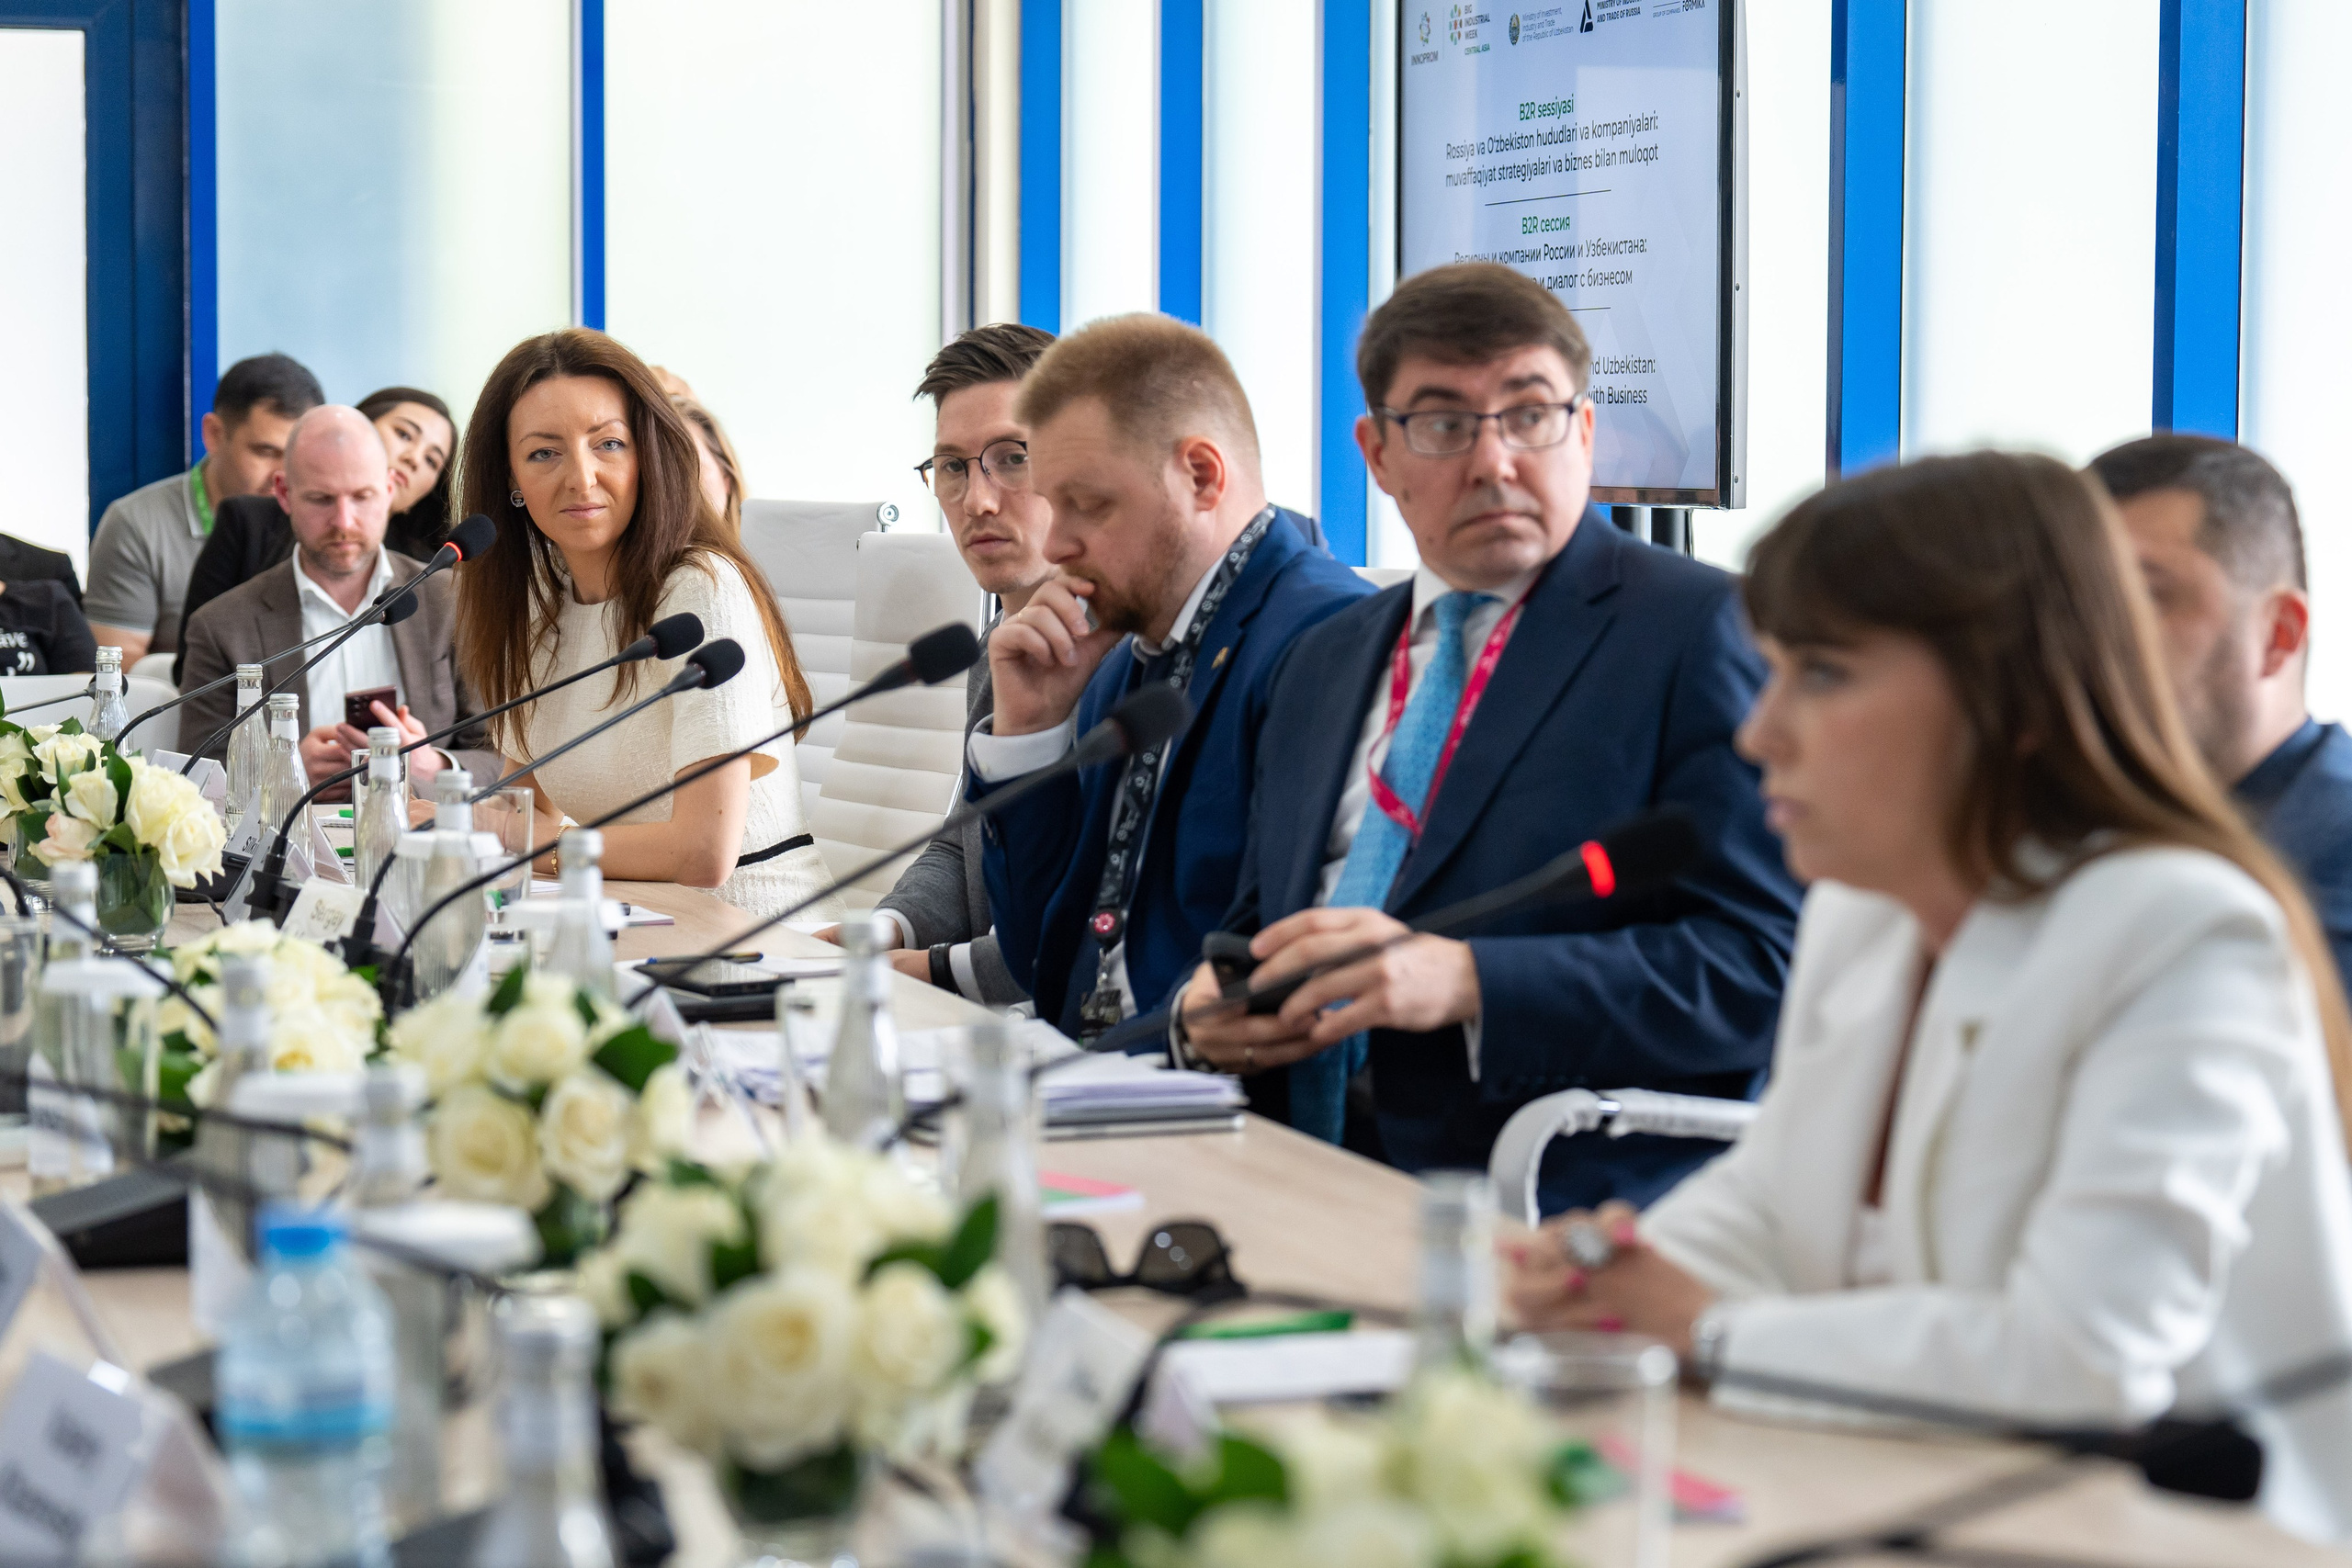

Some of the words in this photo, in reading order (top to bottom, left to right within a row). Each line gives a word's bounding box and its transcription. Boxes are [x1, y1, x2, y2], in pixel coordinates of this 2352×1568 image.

[1597, 13, 1606, 23] AND
[1606, 10, 1620, 21] TRADE
[1620, 9, 1625, 18] OF
[1625, 6, 1641, 17] RUSSIA
[1520, 101, 1536, 121] B2R
[1537, 93, 1574, 119] sessiyasi
[1446, 139, 1475, 162] Rossiya
[1476, 141, 1486, 155] va
[1536, 122, 1577, 147] hududlari
[1579, 125, 1589, 141] va
[1592, 110, 1658, 141] kompaniyalari:
[1445, 164, 1497, 187] muvaffaqiyat
[1498, 155, 1551, 182] strategiyalari
[1553, 158, 1563, 174] va
[1565, 152, 1593, 172] biznes
[1595, 147, 1617, 168] bilan
[1619, 143, 1658, 166] muloqot
[1521, 216, 1539, 235] B2R
[1540, 216, 1570, 232] сессия
[1491, 252, 1497, 265] и
[1498, 248, 1542, 265] компании
[1544, 243, 1576, 261] России
[1577, 243, 1584, 258] и
[1585, 237, 1647, 258] Узбекистана:
[1546, 274, 1578, 292] диалог
[1579, 273, 1586, 288] с
[1587, 267, 1633, 288] бизнесом
[1589, 355, 1600, 376] nd
[1602, 355, 1656, 375] Uzbekistan:
[1607, 384, 1648, 404] Business
[311, 897, 345, 933] Sergey
